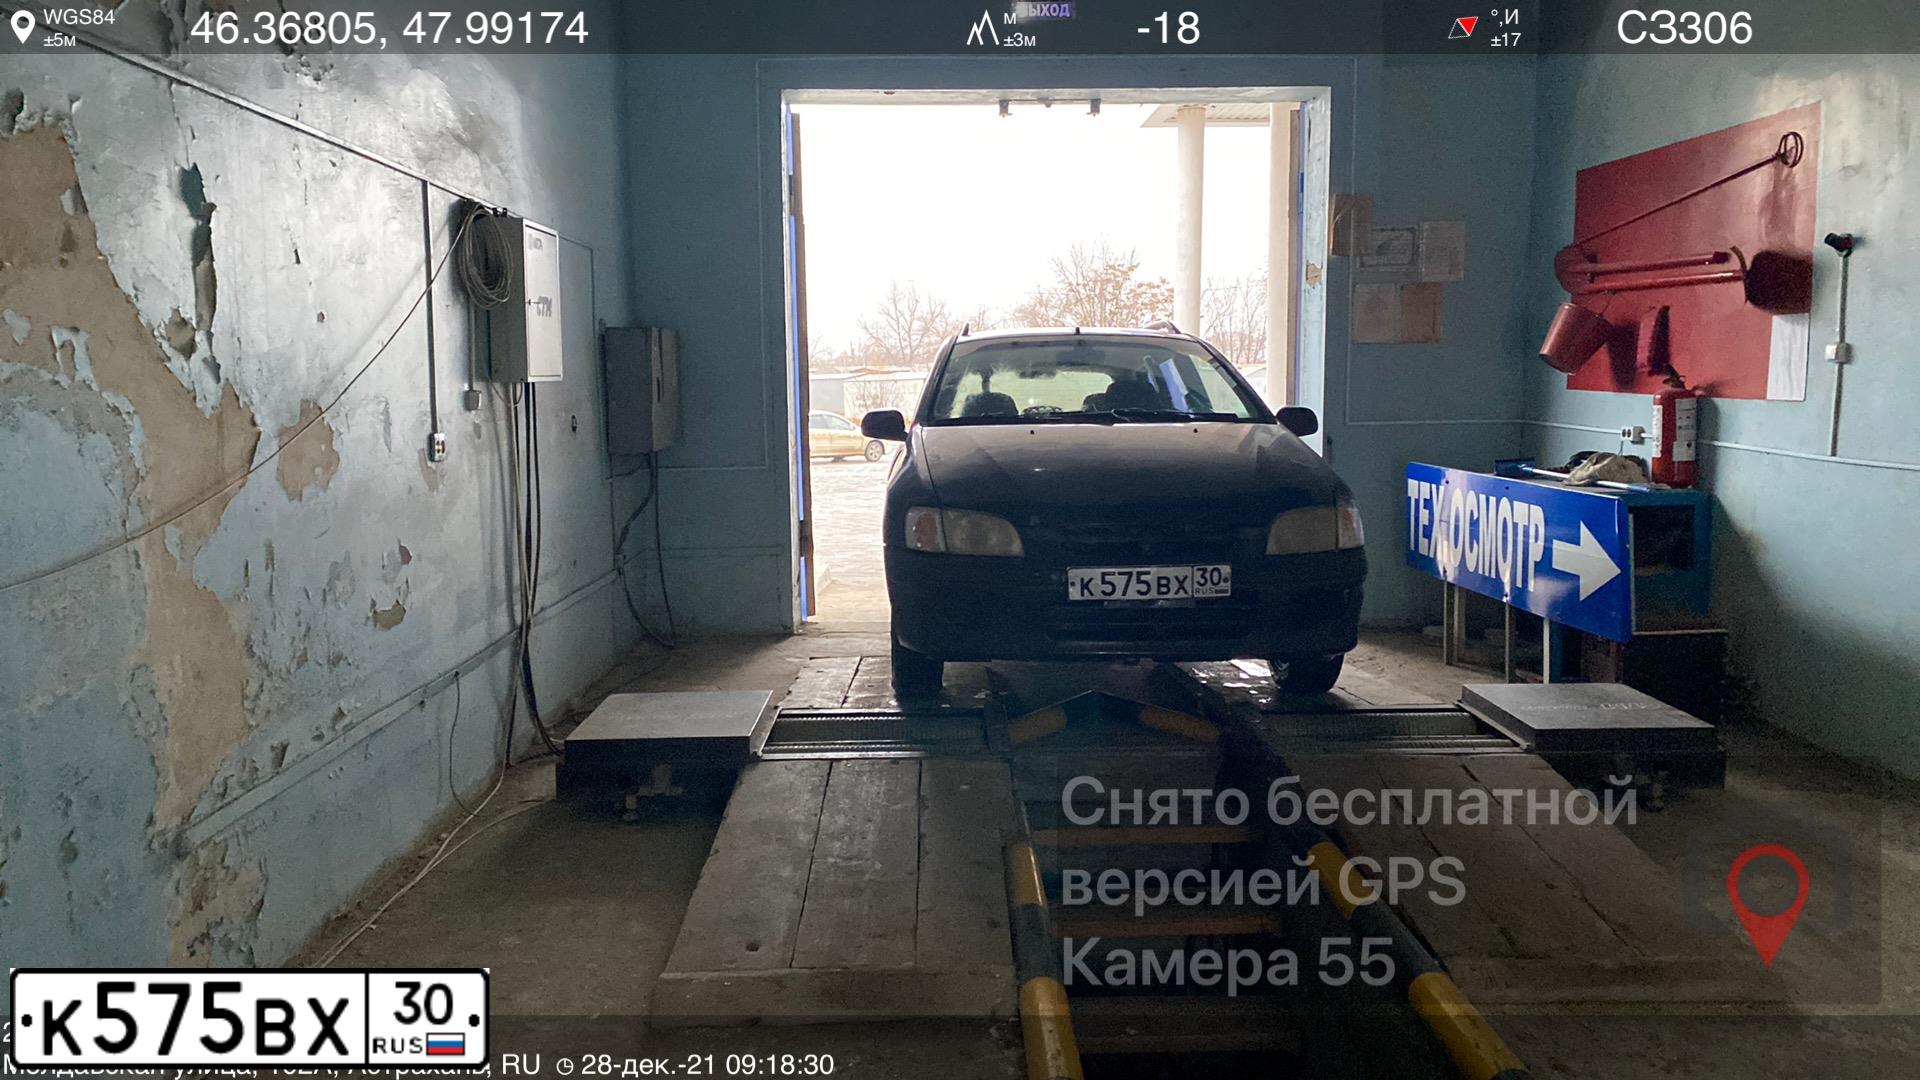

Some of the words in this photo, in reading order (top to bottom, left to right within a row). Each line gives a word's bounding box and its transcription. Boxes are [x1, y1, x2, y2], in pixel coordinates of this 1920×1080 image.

[1017, 3, 1070, 17] ЫХОД
[1407, 479, 1545, 592] ТЕХОСМОТР
[1196, 567, 1222, 586] 30
[1195, 587, 1215, 595] RUS
